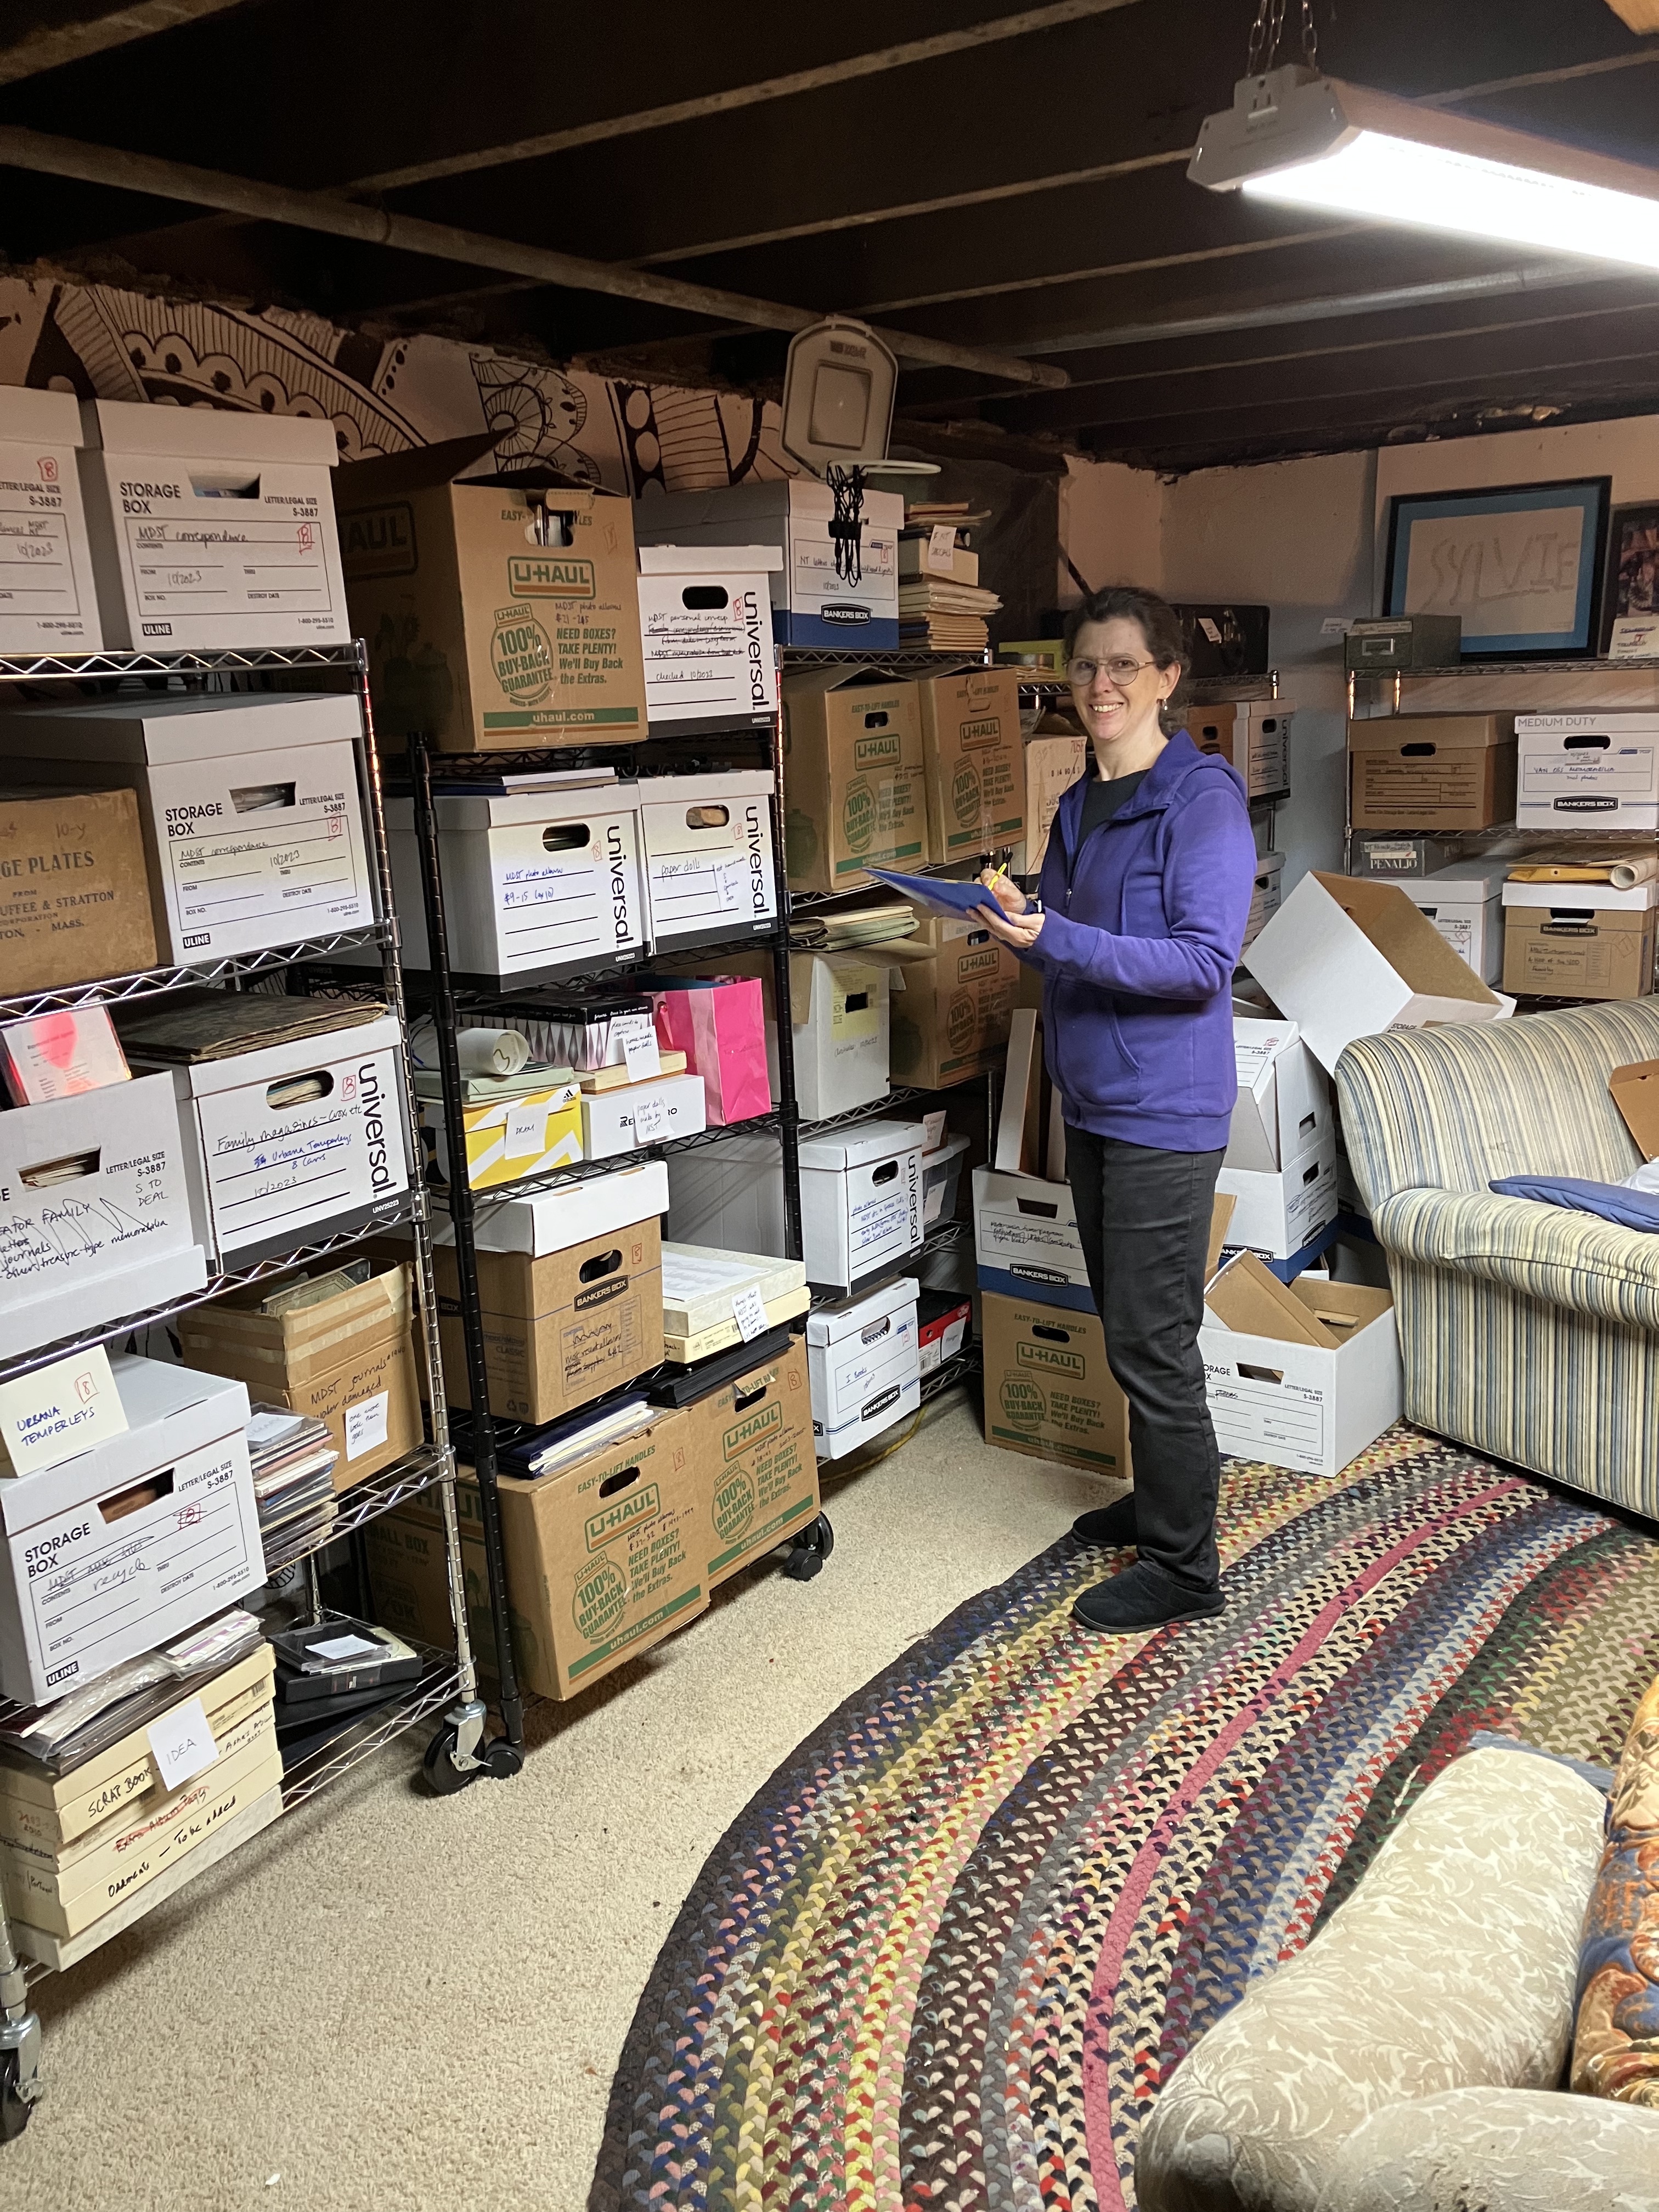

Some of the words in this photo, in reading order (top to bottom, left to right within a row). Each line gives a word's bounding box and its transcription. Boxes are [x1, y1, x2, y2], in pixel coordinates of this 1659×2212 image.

[120, 481, 181, 499] STORAGE
[264, 495, 304, 505] LETTER/LEGAL
[306, 497, 318, 505] SIZE
[29, 496, 61, 507] S-3887
[123, 500, 152, 514] BOX
[292, 507, 318, 517] S-3887
[514, 564, 590, 584] U-HAUL
[824, 610, 854, 619] BANKERS
[855, 610, 868, 619] BOX
[144, 624, 171, 635] ULINE
[557, 628, 580, 640] NEED
[583, 628, 616, 640] BOXES?
[497, 624, 541, 656] 100%
[558, 643, 580, 654] TAKE
[582, 643, 617, 654] PLENTY!
[744, 591, 770, 707] universal
[498, 649, 550, 677] BUY-BACK
[559, 658, 580, 669] We'll
[583, 658, 600, 672] Buy
[602, 658, 623, 669] Back
[560, 674, 575, 684] the
[577, 674, 607, 684] Extras.
[656, 670, 685, 681] checked
[533, 712, 595, 723] uhaul.com
[1517, 717, 1563, 727] MEDIUM
[1566, 716, 1597, 726] DUTY
[963, 723, 998, 739] U-HAUL
[857, 740, 898, 758] U-HAUL
[299, 795, 334, 805] LETTER/LEGAL
[324, 803, 346, 814] S-3887
[165, 803, 223, 822] STORAGE
[167, 822, 195, 837] BOX
[28, 850, 95, 874] PLATES
[662, 865, 681, 883] paper
[684, 857, 701, 872] dolls
[746, 806, 770, 914] universal
[1370, 859, 1418, 870] PENALJO
[13, 889, 37, 898] FROM
[607, 826, 634, 944] universal
[42, 900, 51, 910] &
[56, 890, 115, 908] STRATTON
[52, 918, 85, 932] MASS.
[184, 934, 210, 947] ULINE
[345, 1078, 355, 1094] 8
[637, 1103, 651, 1115] paper
[217, 1131, 255, 1153] Family
[261, 1119, 319, 1141] magazines
[349, 1104, 363, 1115] etc
[359, 1063, 397, 1193] universal
[106, 1156, 151, 1175] LETTER/LEGAL
[152, 1151, 165, 1161] SIZE
[272, 1146, 305, 1162] Urbana
[137, 1161, 166, 1177] S-3887
[136, 1183, 143, 1193] S
[149, 1178, 162, 1189] TO
[254, 1176, 297, 1197] 10/2023
[138, 1191, 169, 1207] DEAL
[372, 1199, 399, 1214] UNV25223
[908, 1155, 921, 1244] universal
[42, 1203, 90, 1224] FAMILY
[2, 1241, 52, 1269] journals
[1013, 1267, 1048, 1280] BANKERS
[1049, 1275, 1066, 1284] BOX
[577, 1286, 611, 1307] BANKERS
[611, 1279, 627, 1291] BOX
[441, 1302, 460, 1312] BOX
[1014, 1313, 1056, 1328] EASY-TO-LIFT
[1057, 1322, 1087, 1334] HANDLES
[1021, 1346, 1081, 1370] U-HAUL
[311, 1378, 341, 1405] MDST
[348, 1357, 387, 1392] journals
[342, 1375, 381, 1407] damaged
[1284, 1384, 1313, 1393] LETTER/LEGAL
[864, 1397, 888, 1415] BANKERS
[888, 1389, 899, 1400] BOX
[1005, 1384, 1038, 1400] 100%
[1050, 1391, 1070, 1402] NEED
[1071, 1396, 1101, 1409] BOXES?
[1304, 1393, 1323, 1402] S-3887
[1004, 1400, 1044, 1411] BUY-BACK
[1051, 1401, 1068, 1410] TAKE
[1070, 1405, 1101, 1418] PLENTY!
[16, 1406, 60, 1431] URBANA
[21, 1406, 95, 1447] TEMPERLEYS
[349, 1413, 362, 1423] one
[1070, 1414, 1085, 1425] Buy
[727, 1409, 779, 1448] U-HAUL
[755, 1458, 773, 1475] NEED
[774, 1442, 797, 1464] BOXES?
[178, 1466, 221, 1493] LETTER/LEGAL
[221, 1459, 233, 1473] SIZE
[207, 1469, 234, 1489] S-3887
[578, 1462, 624, 1494] EASY-TO-LIFT
[624, 1444, 656, 1469] HANDLES
[757, 1469, 774, 1486] TAKE
[774, 1453, 798, 1477] PLENTY!
[775, 1474, 786, 1490] Buy
[787, 1463, 802, 1479] Back
[716, 1477, 747, 1511] 100%
[759, 1495, 769, 1509] the
[589, 1491, 656, 1537] U-HAUL
[716, 1488, 753, 1528] BUY-BACK
[24, 1522, 91, 1563] STORAGE
[740, 1516, 784, 1550] uhaul.com
[628, 1547, 648, 1567] NEED
[651, 1527, 680, 1551] BOXES?
[27, 1553, 59, 1579] BOX
[575, 1553, 606, 1582] U-HAUL
[630, 1560, 650, 1579] TAKE
[651, 1539, 681, 1566] PLENTY!
[93, 1558, 151, 1592] recycle
[631, 1573, 651, 1591] We'll
[652, 1564, 666, 1582] Buy
[668, 1550, 687, 1568] Back
[161, 1579, 183, 1595] DESTROY
[183, 1571, 194, 1583] DATE
[578, 1565, 616, 1609] 100%
[633, 1588, 646, 1604] the
[647, 1575, 673, 1596] Extras.
[41, 1587, 71, 1606] CONTENTS
[578, 1582, 625, 1628] BUY-BACK
[45, 1616, 63, 1629] FROM
[610, 1610, 664, 1651] uhaul.com
[49, 1641, 63, 1652] BOX
[47, 1662, 79, 1688] ULINE
[167, 1737, 198, 1765] IDEA
[88, 1784, 122, 1819] SCRAP
[125, 1766, 153, 1795] BOOK
[173, 1828, 187, 1844] To
[189, 1825, 202, 1836] be
